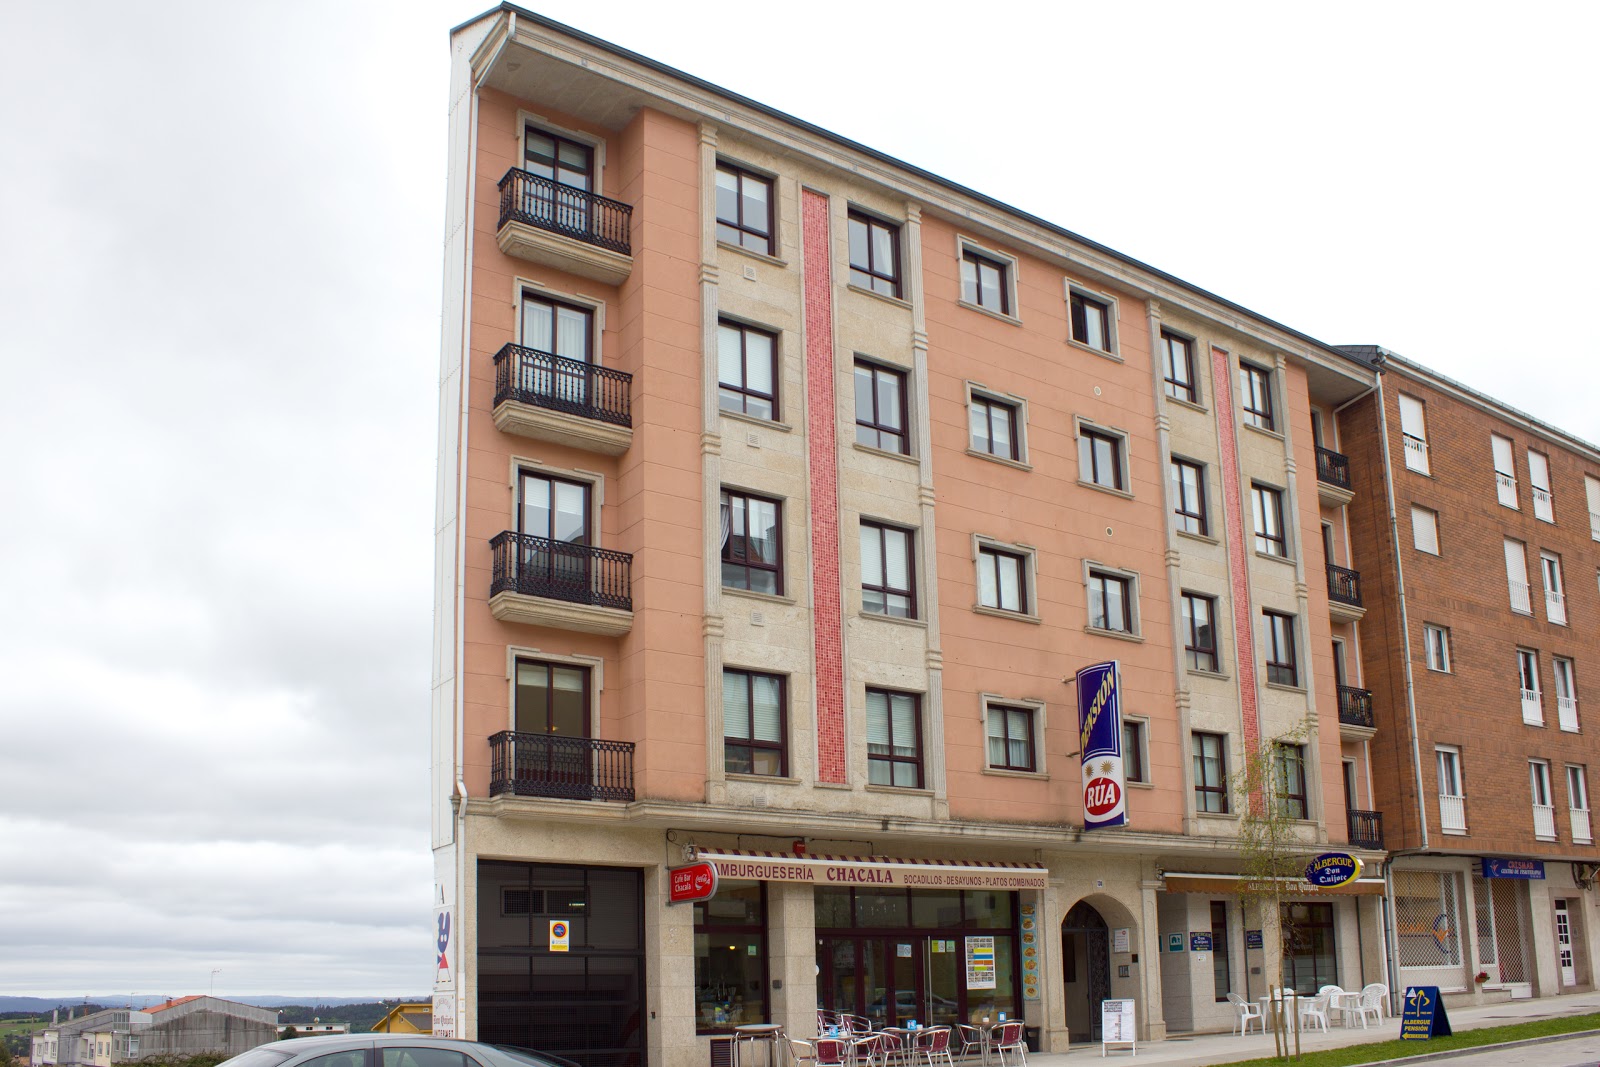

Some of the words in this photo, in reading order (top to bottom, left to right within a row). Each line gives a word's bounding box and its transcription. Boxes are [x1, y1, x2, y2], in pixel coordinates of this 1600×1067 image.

[1081, 666, 1115, 759] PENSIÓN
[1087, 777, 1115, 809] RÚA
[1314, 857, 1352, 872] ALBERGUE
[1324, 867, 1340, 875] Don
[714, 863, 814, 880] AMBURGUESERÍA
[827, 867, 893, 883] CHACALA
[904, 874, 942, 885] BOCADILLOS
[947, 875, 982, 886] DESAYUNOS
[985, 877, 1007, 886] PLATOS
[1009, 878, 1044, 887] COMBINADOS
[1319, 875, 1347, 883] Quijote
[675, 882, 691, 892] Chacala
